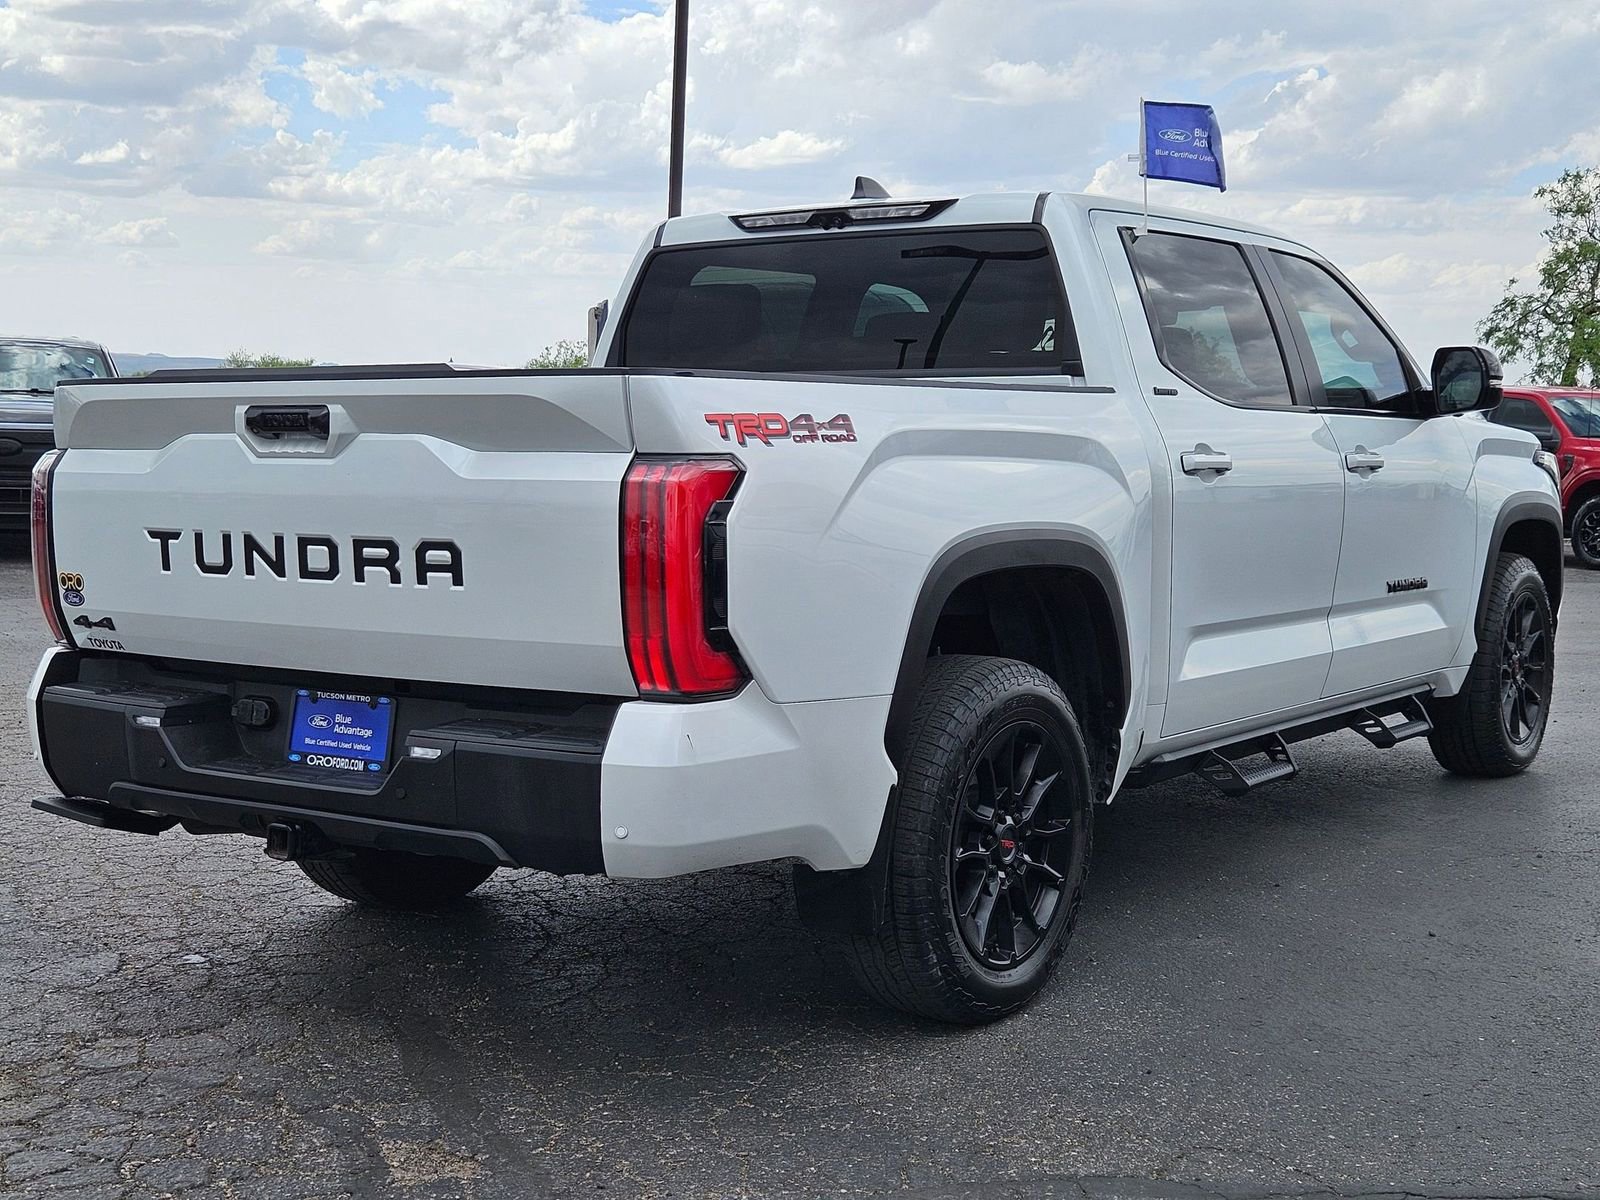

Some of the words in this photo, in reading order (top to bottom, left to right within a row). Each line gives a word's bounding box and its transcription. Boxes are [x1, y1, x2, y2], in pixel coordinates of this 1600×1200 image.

[1170, 150, 1197, 160] Certified
[265, 414, 306, 426] TOYOTA
[704, 413, 790, 447] TRD
[793, 434, 819, 444] OFF
[822, 434, 857, 444] ROAD
[143, 527, 465, 591] TUNDRA
[59, 573, 84, 591] ORO
[1386, 576, 1428, 593] TUNDRA
[87, 637, 126, 651] TOYOTA
[317, 692, 345, 700] TUCSON
[346, 694, 371, 703] METRO
[311, 716, 329, 727] Ford
[335, 714, 352, 724] Blue
[333, 725, 373, 738] Advantage
[317, 739, 338, 748] Certified
[353, 743, 371, 751] Vehicle
